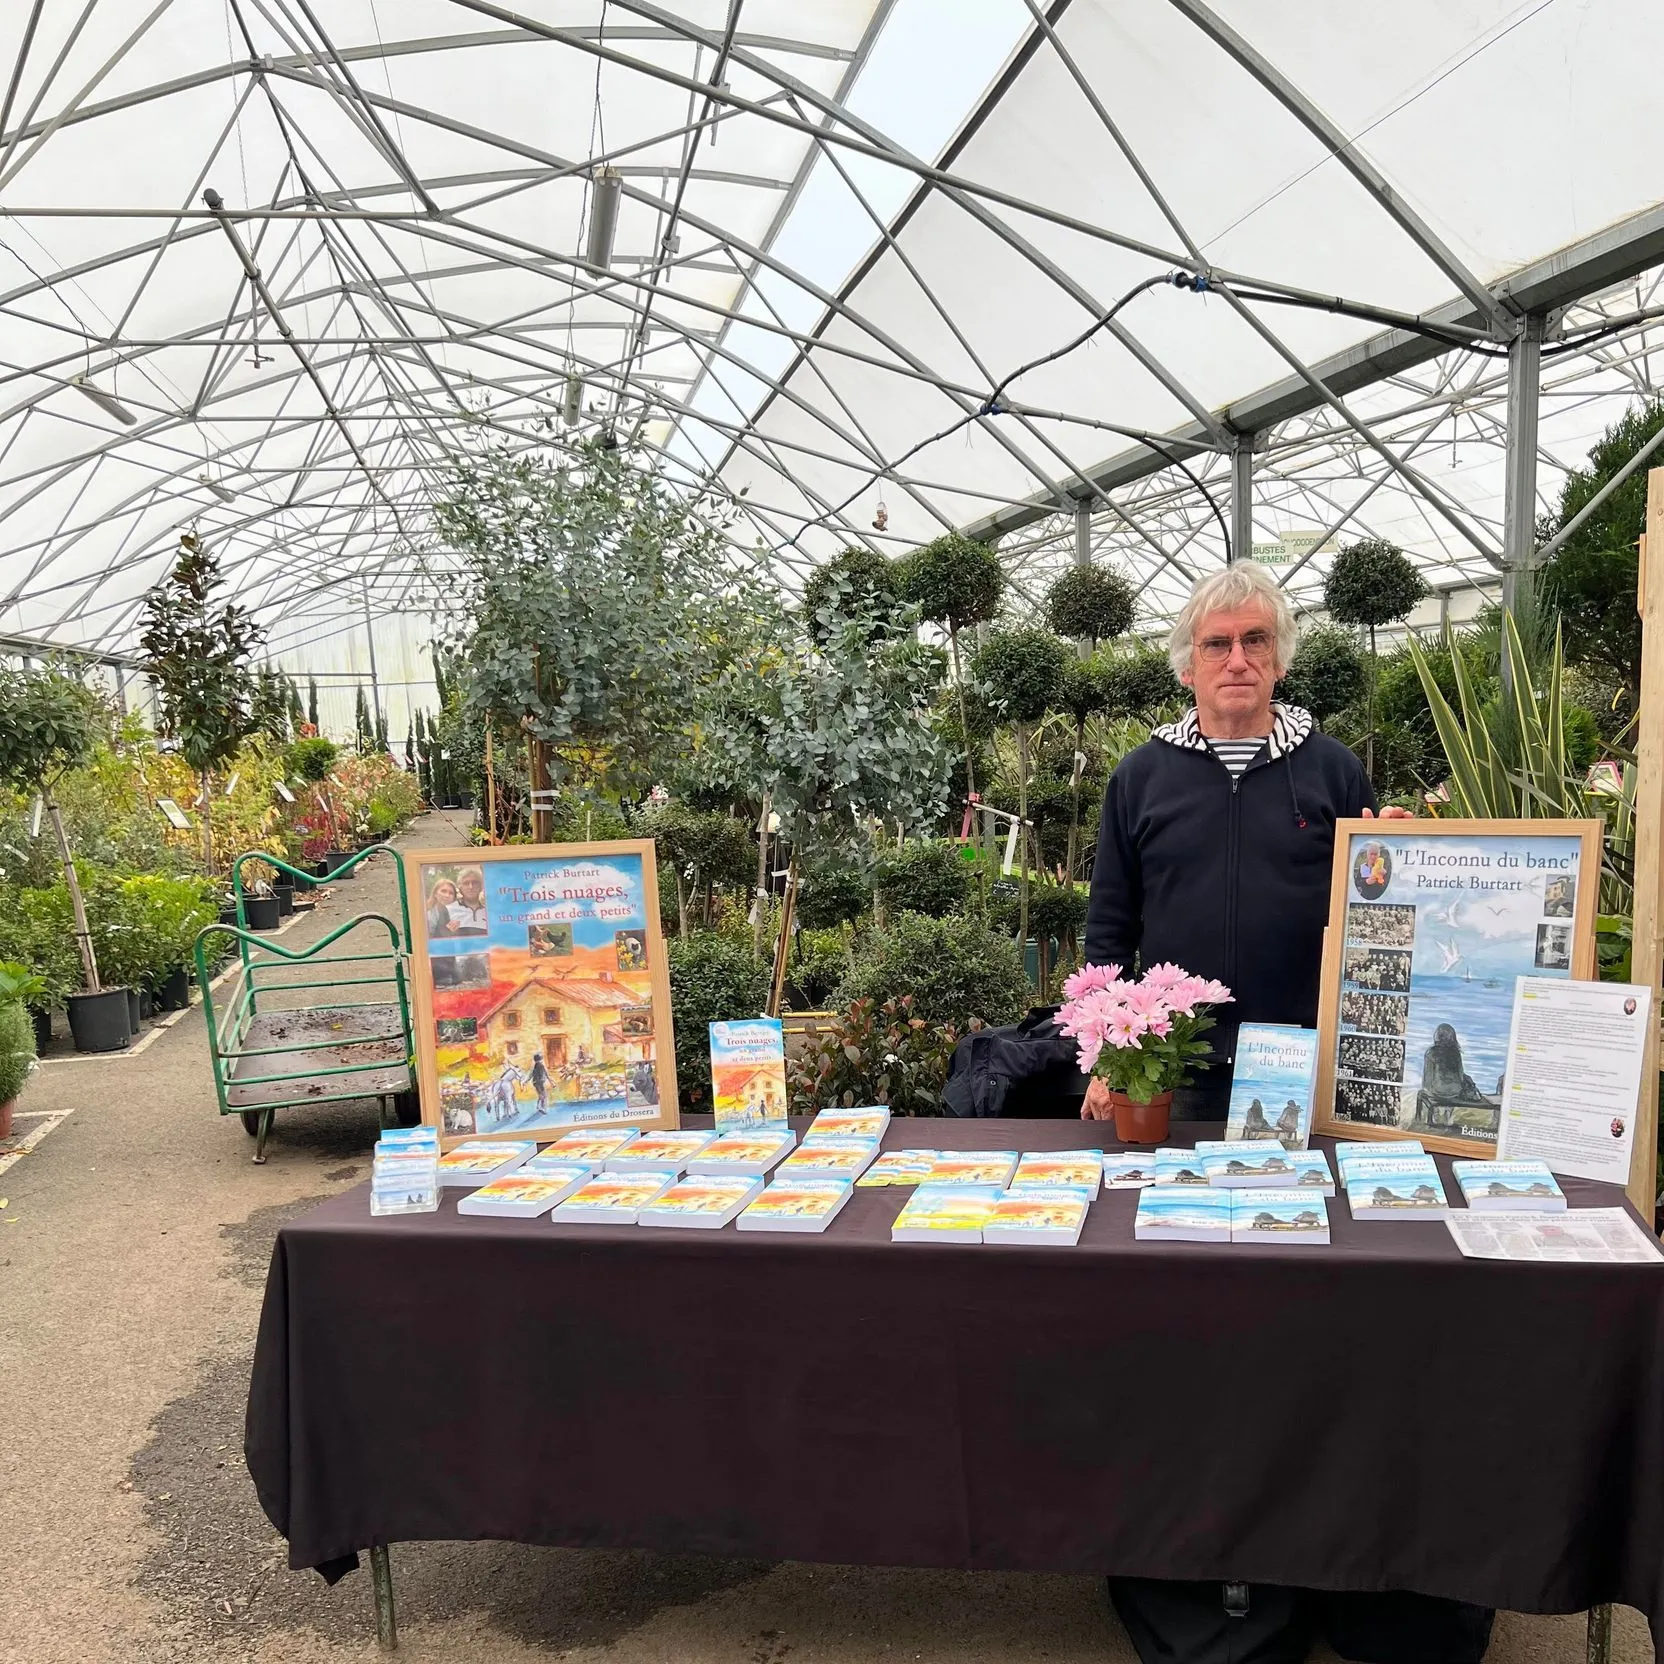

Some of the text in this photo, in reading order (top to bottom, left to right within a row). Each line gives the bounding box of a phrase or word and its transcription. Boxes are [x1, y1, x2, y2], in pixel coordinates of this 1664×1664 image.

[1252, 555, 1291, 563] NEMENT
[1395, 849, 1578, 869] "L'Inconnu du banc"
[523, 868, 600, 880] Patrick Burtart
[1416, 874, 1523, 891] Patrick Burtart
[562, 885, 629, 903] nuages,
[498, 903, 637, 924] un grand et deux petits"
[1340, 1025, 1356, 1033] 1960
[1248, 1042, 1307, 1056] L'Inconnu
[1259, 1055, 1305, 1069] du banc
[1337, 1069, 1353, 1078] 1961
[573, 1112, 608, 1122] Éditions
[609, 1110, 620, 1119] du
[1461, 1125, 1498, 1139] Éditions
